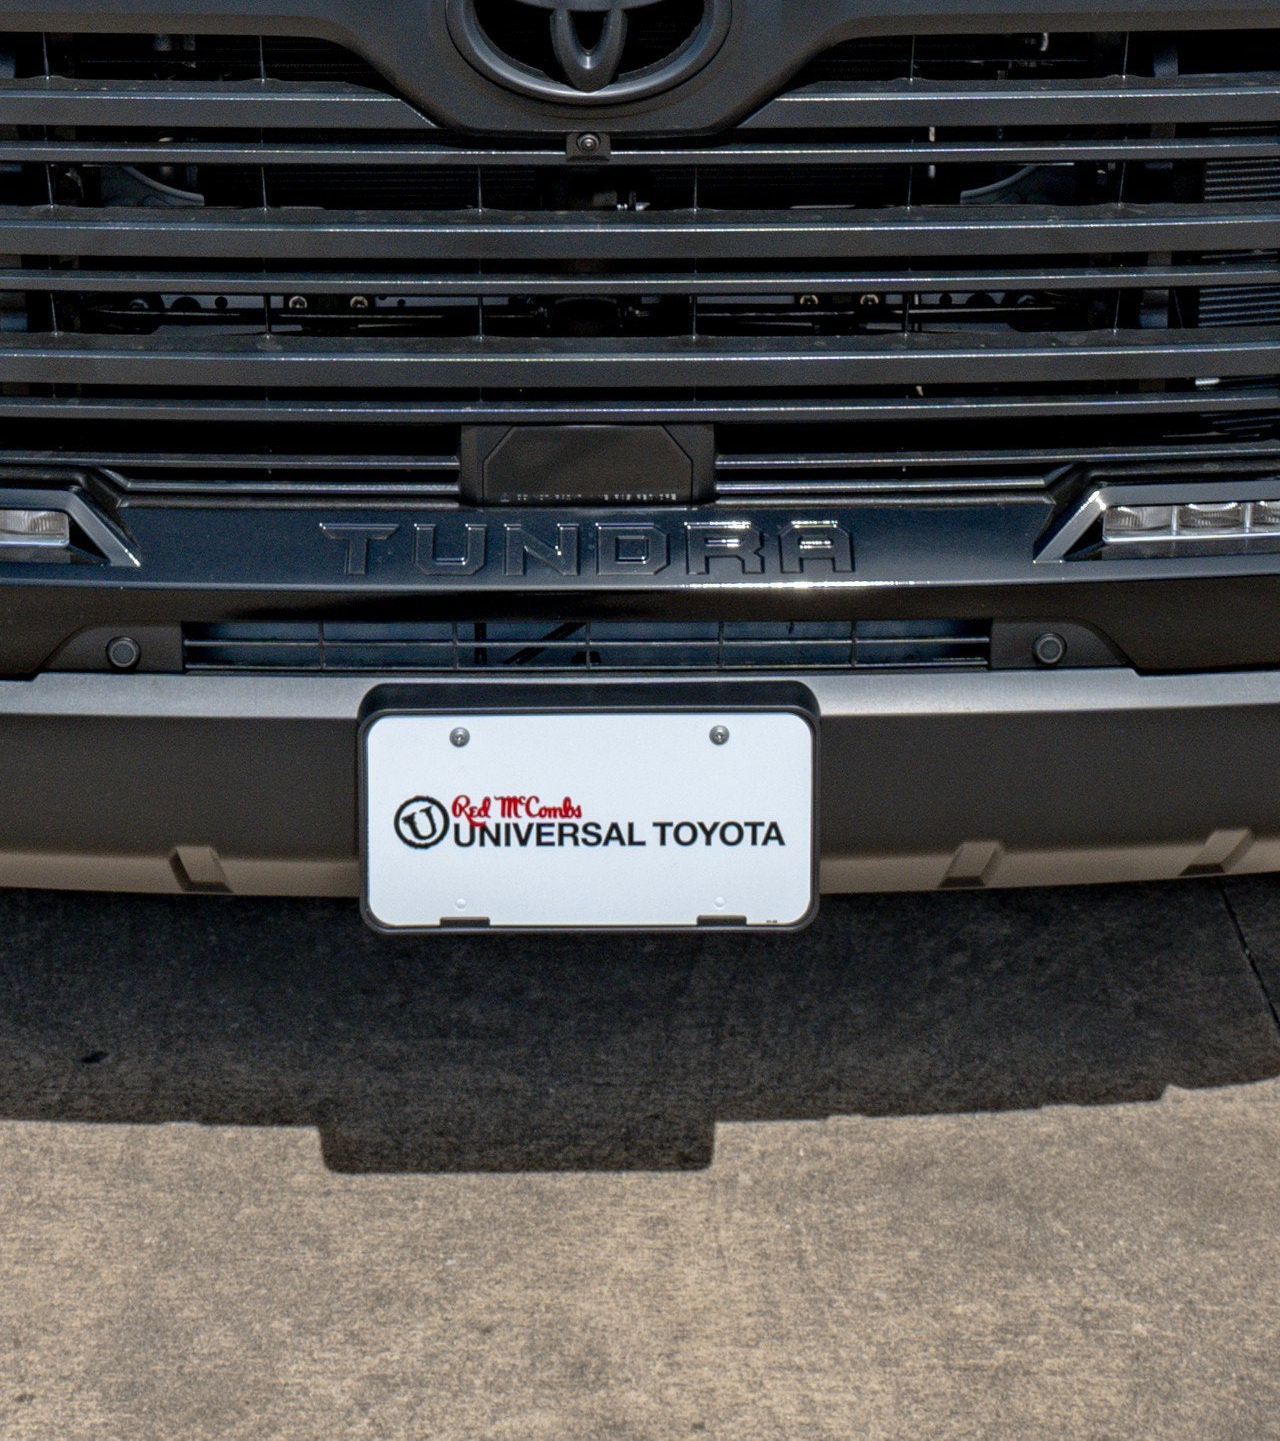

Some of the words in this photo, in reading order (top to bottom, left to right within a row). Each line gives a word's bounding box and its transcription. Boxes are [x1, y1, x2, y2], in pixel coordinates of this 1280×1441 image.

[319, 520, 857, 576] TUNDRA
[452, 795, 492, 827] Red
[495, 795, 582, 819] McCombs
[454, 822, 646, 847] UNIVERSAL
[654, 822, 785, 847] TOYOTA
